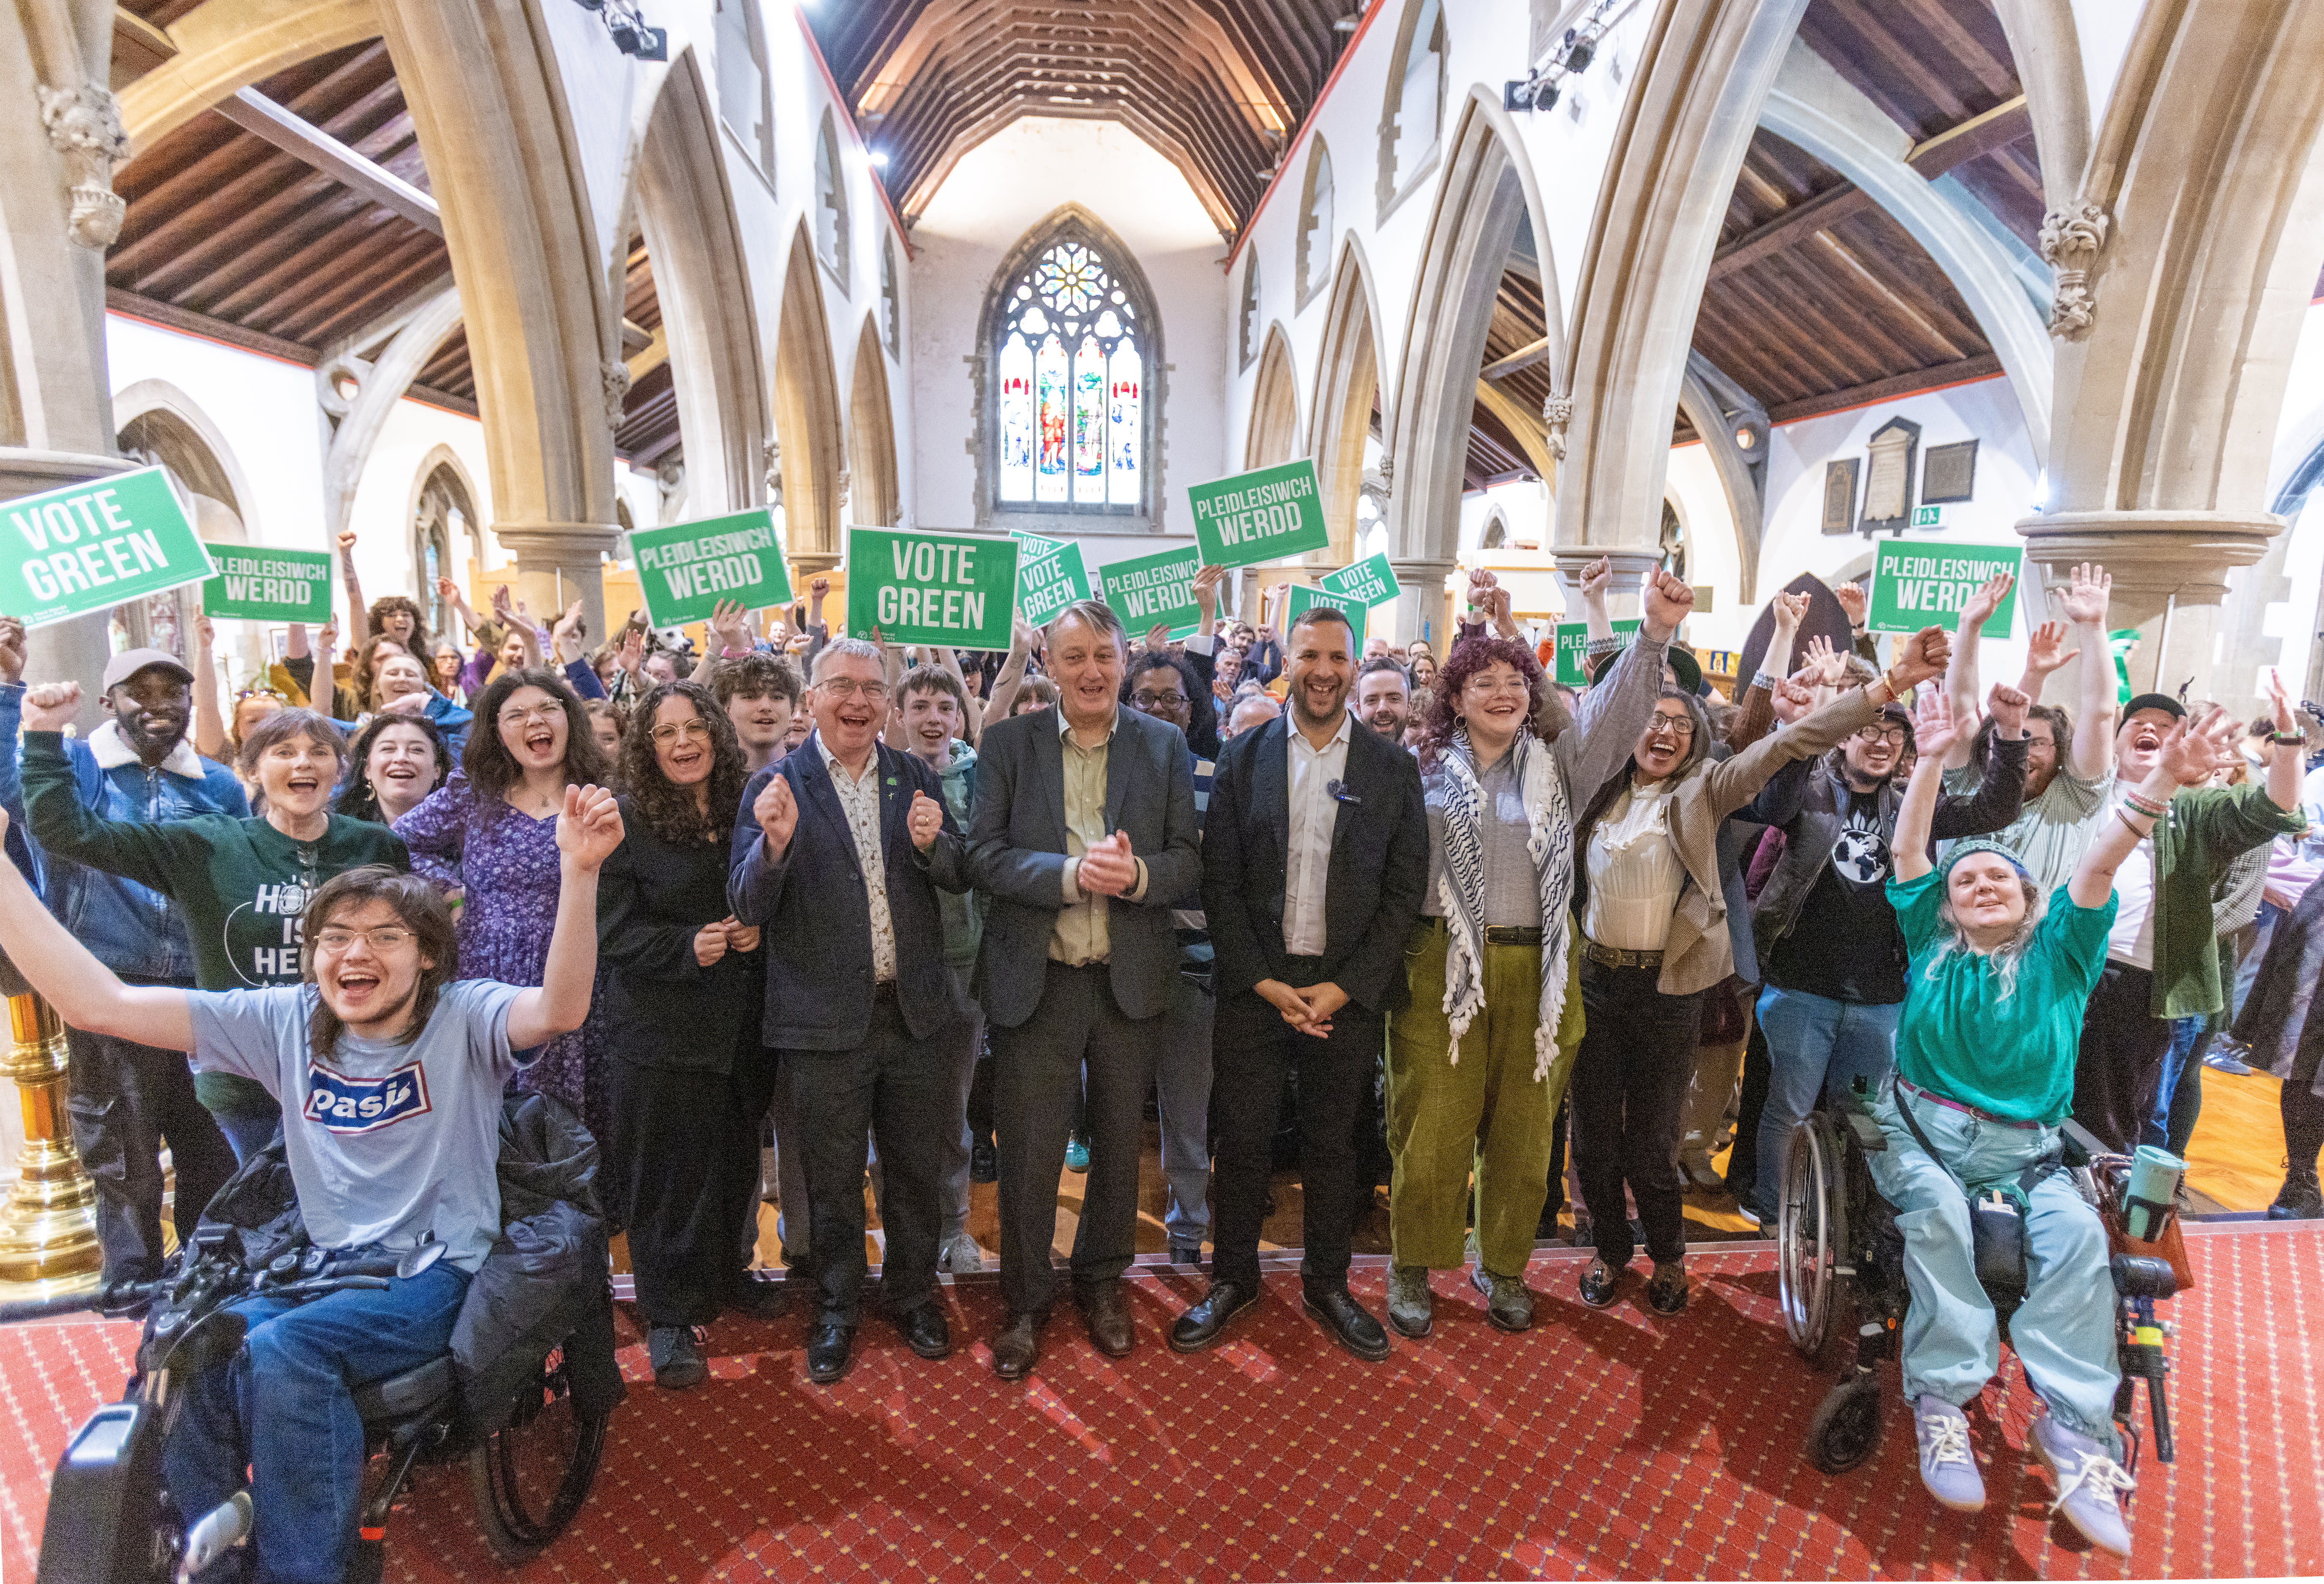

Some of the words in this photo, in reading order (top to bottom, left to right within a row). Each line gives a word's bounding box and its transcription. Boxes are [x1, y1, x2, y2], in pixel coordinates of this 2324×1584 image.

[1196, 476, 1312, 520] PLEIDLEISIWCH
[9, 488, 133, 551] VOTE
[1216, 502, 1302, 546] WERDD
[22, 528, 170, 601] GREEN
[639, 526, 773, 571] PLEIDLEISIWCH
[892, 540, 977, 585] VOTE
[1022, 536, 1052, 555] VOTE
[663, 553, 763, 600] WERDD
[1021, 554, 1065, 592] VOTE
[1107, 558, 1202, 595] PLEIDLEISIWC
[1337, 561, 1375, 590] VOTE
[1882, 556, 2014, 581] PLEIDLEISIWCH
[224, 575, 311, 605] WERDD
[878, 586, 985, 630] GREEN
[1024, 576, 1077, 619] GREEN
[1124, 579, 1198, 618] WERDD
[1310, 593, 1349, 613] VOTE
[1342, 577, 1387, 602] REEN
[1897, 578, 1986, 613] WERD
